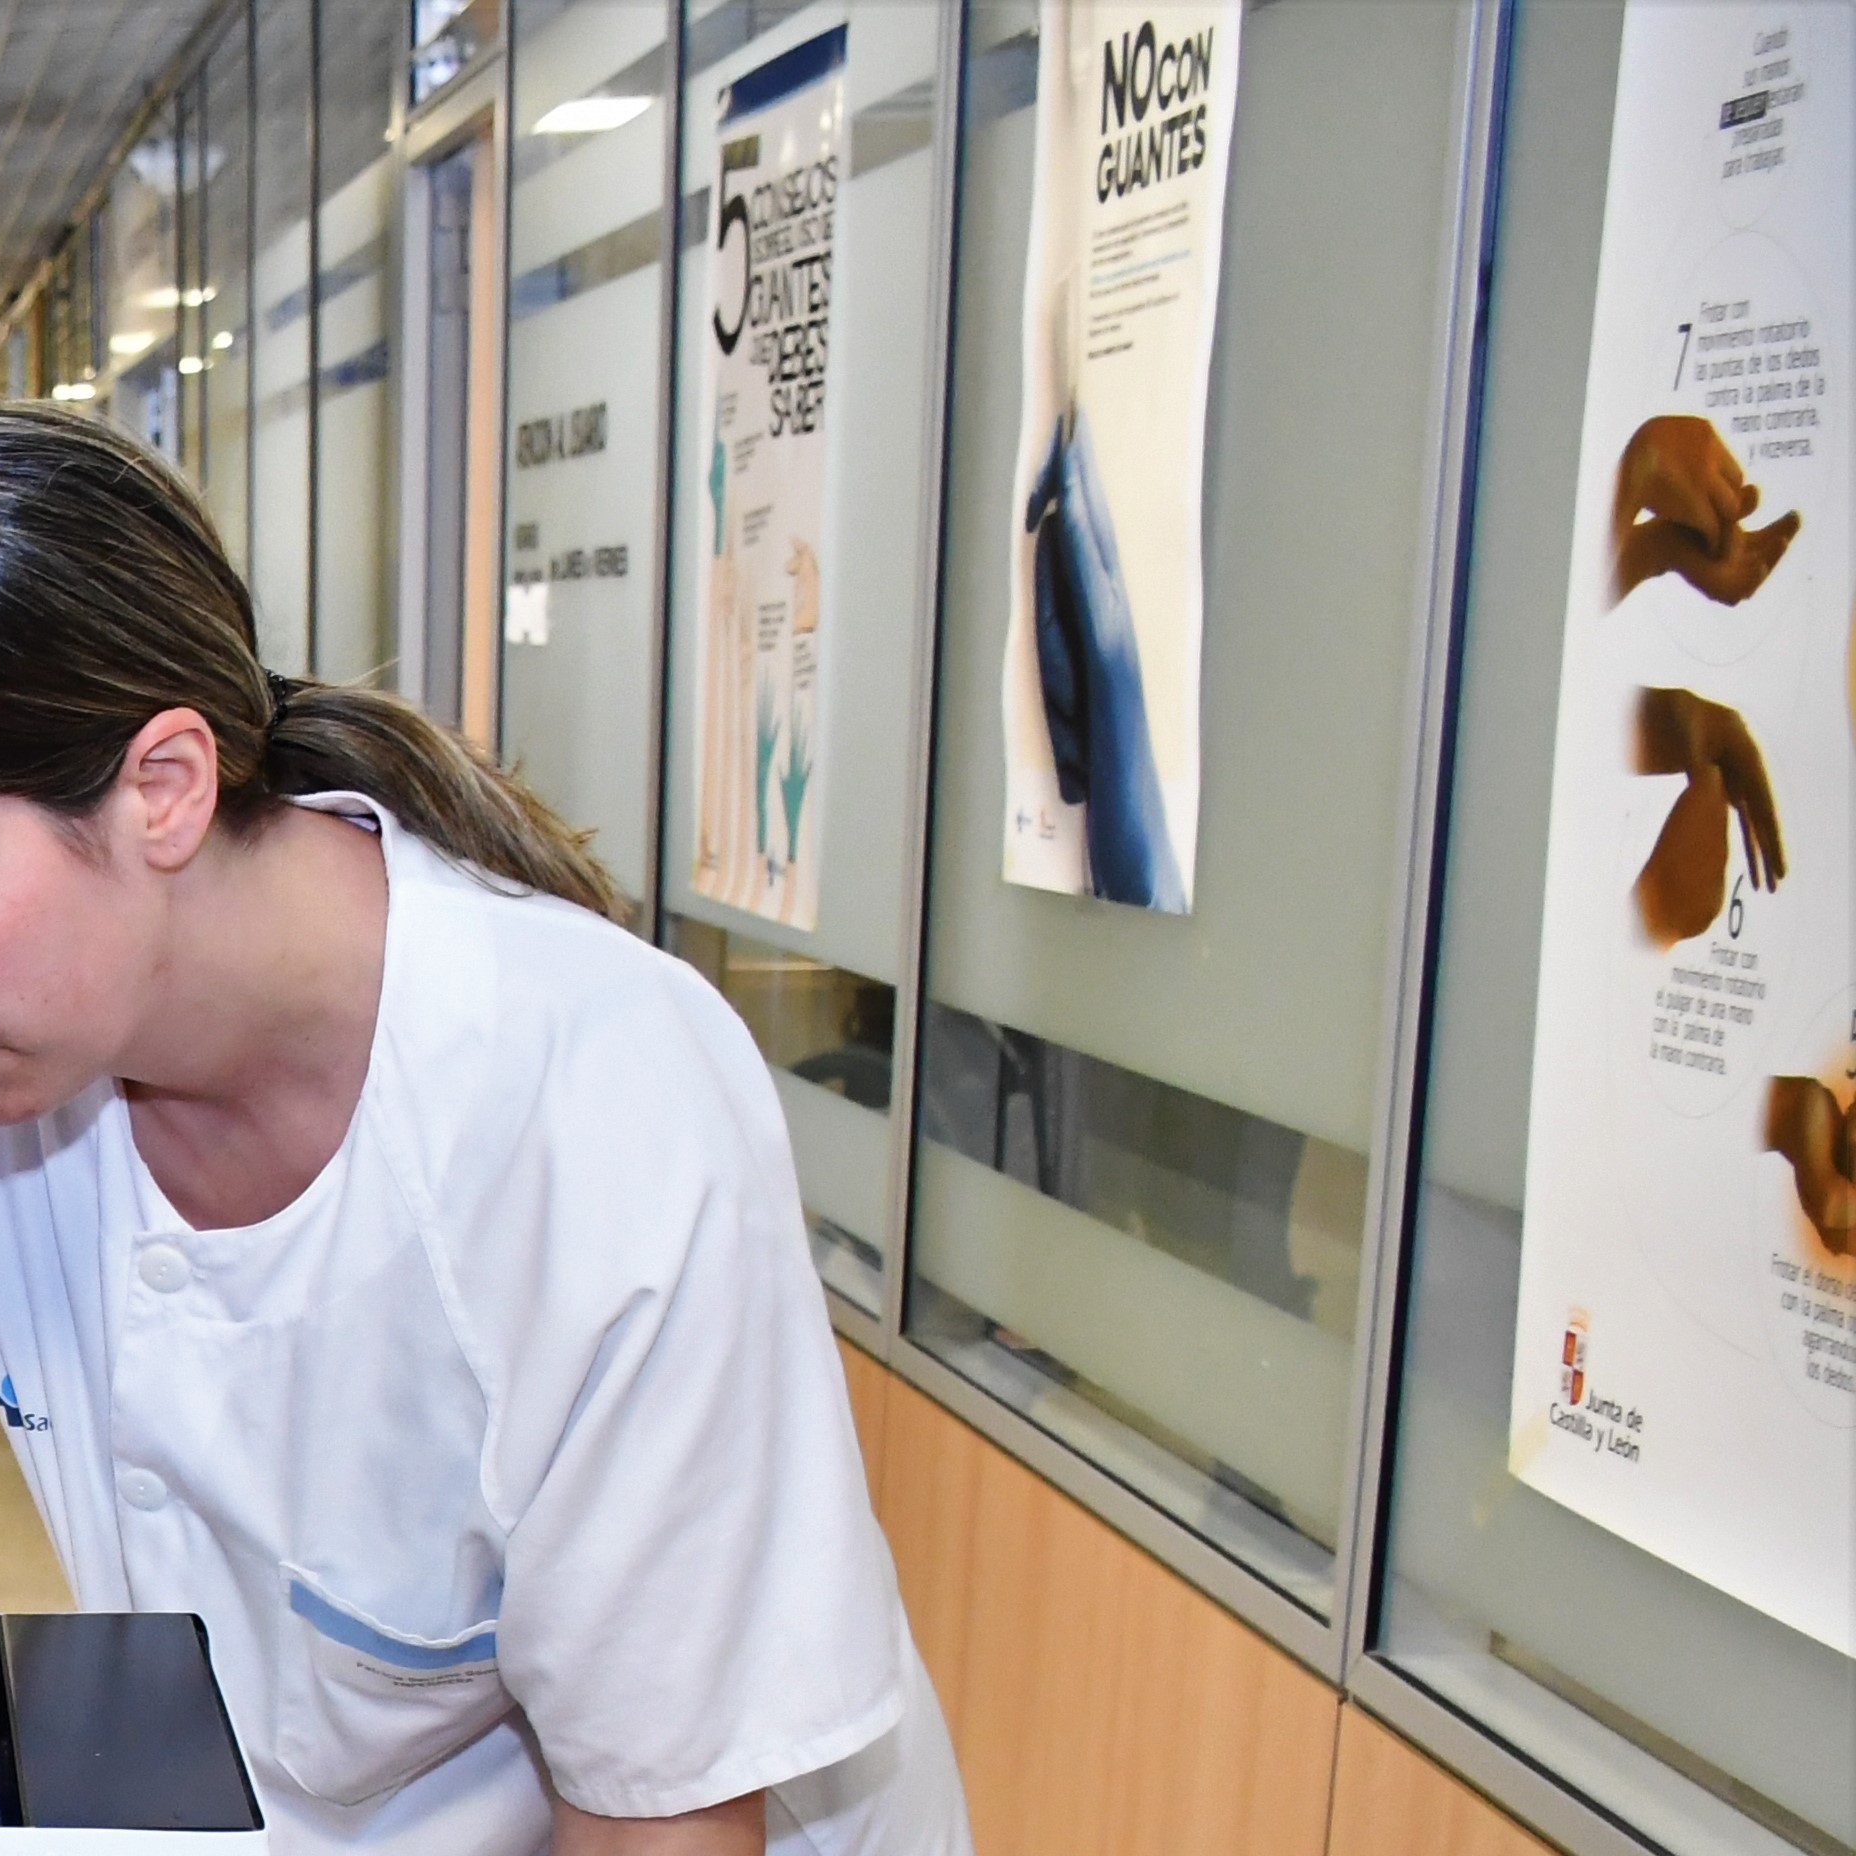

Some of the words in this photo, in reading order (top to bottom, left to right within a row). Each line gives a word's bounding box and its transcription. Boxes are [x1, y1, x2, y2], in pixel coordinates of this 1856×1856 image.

[1101, 20, 1156, 136] NO
[1157, 26, 1214, 111] CON
[1096, 103, 1207, 204] GUANTES
[713, 134, 760, 357] 5
[1674, 323, 1693, 391] 7
[1728, 874, 1744, 939] 6
[1549, 1402, 1593, 1442] Castilla
[1594, 1427, 1605, 1453] y
[1607, 1427, 1641, 1463] León
[1585, 1388, 1623, 1424] Junta
[1626, 1407, 1644, 1434] de
